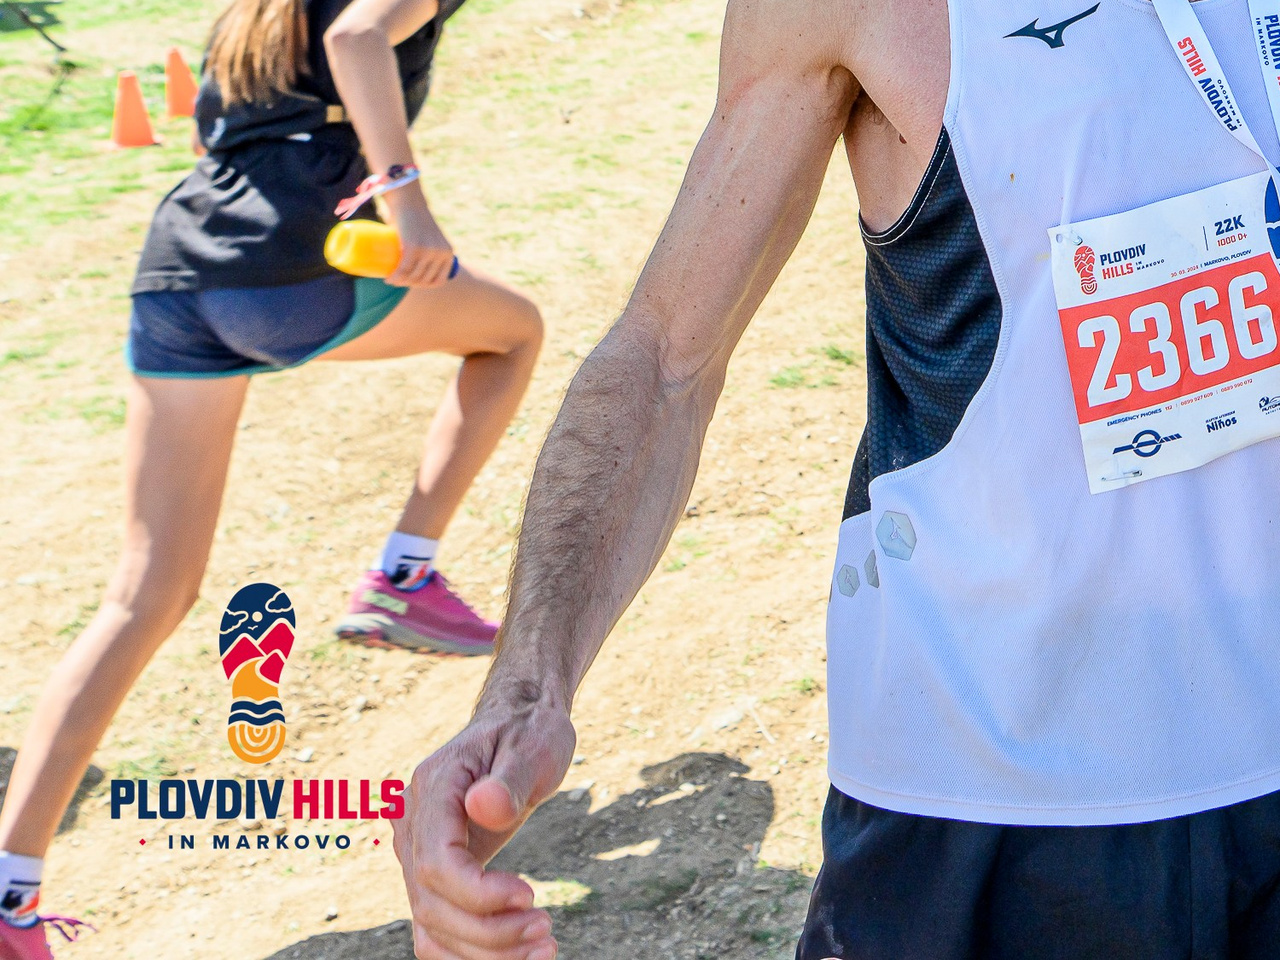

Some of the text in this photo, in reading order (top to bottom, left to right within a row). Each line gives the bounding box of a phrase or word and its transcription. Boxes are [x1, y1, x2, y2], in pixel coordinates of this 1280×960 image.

[1257, 28, 1270, 66] MARKOVO
[1177, 36, 1238, 132] PLOVDIV HILLS
[1214, 214, 1245, 236] 22K
[1217, 234, 1237, 247] 1000
[1099, 243, 1146, 266] PLOVDIV
[1102, 262, 1134, 280] HILLS
[1076, 270, 1279, 409] 2366
[1106, 414, 1140, 427] EMERGENCY
[1140, 407, 1162, 419] PHONES
